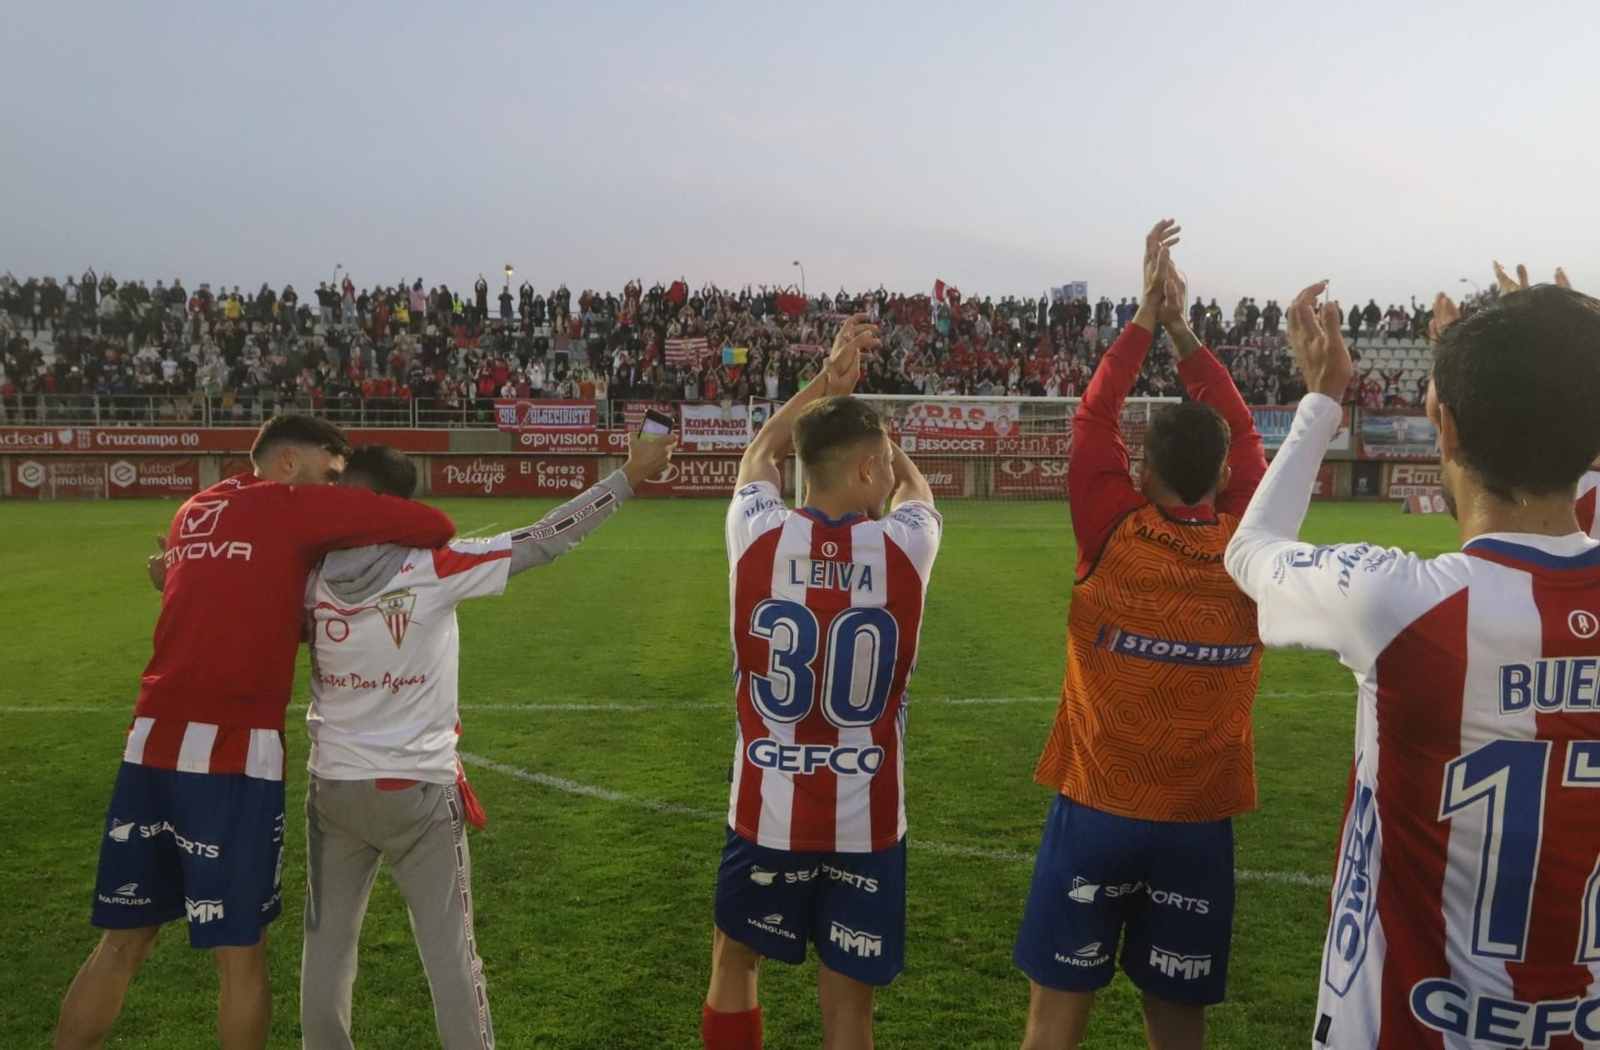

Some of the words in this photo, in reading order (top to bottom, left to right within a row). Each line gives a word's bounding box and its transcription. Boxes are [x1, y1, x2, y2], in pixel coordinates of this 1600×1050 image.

[499, 408, 517, 424] SOY
[684, 418, 747, 429] KOMANDO
[96, 432, 178, 448] Cruzcampo
[182, 432, 200, 446] 00
[684, 429, 716, 437] FUENTE
[717, 429, 748, 437] NUEVA
[917, 439, 986, 451] BESOCCER
[472, 458, 506, 473] Venta
[520, 461, 532, 475] El
[536, 461, 586, 475] Cerezo
[681, 461, 742, 475] HYUN
[139, 475, 193, 486] emotion
[442, 465, 507, 494] Pelayo
[537, 474, 569, 490] Rojo
[680, 475, 738, 484] PERMO
[532, 526, 555, 539] GUESS
[1134, 524, 1225, 563] ALGECIRA
[164, 541, 252, 569] GIVOVA
[788, 558, 874, 594] LEIVA
[749, 598, 899, 729] 30
[349, 672, 378, 690] Dos
[381, 671, 428, 695] Aguas
[1498, 656, 1600, 715] BUE
[747, 738, 885, 776] GEFCO
[139, 820, 220, 859] SEAORTS
[98, 894, 153, 907] MARGUISA
[1104, 880, 1210, 915] SEAORTS
[747, 917, 797, 940] MARGUISA
[829, 923, 882, 958] HMM
[1054, 952, 1110, 967] MARGUISA
[1149, 948, 1212, 980] HMM
